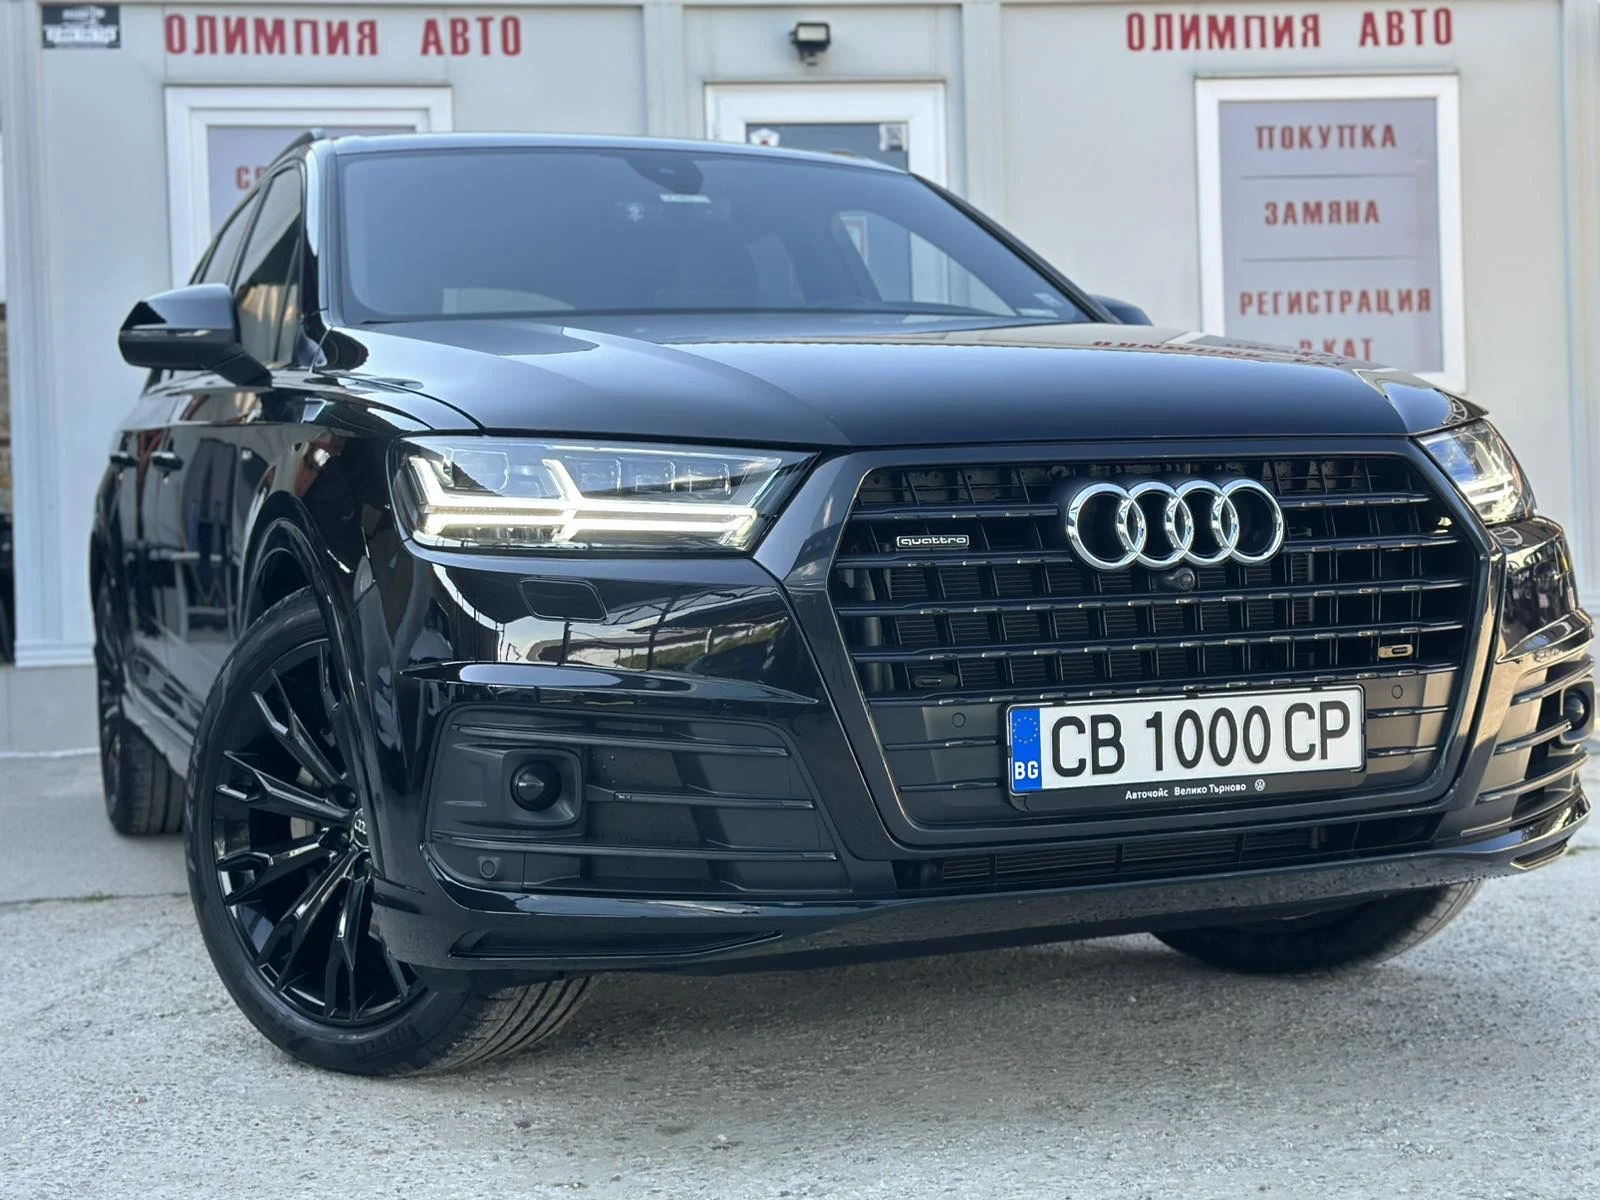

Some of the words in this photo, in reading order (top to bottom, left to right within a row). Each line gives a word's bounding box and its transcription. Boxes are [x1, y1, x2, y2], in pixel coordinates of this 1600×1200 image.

[165, 14, 379, 56] ОЛИМПИЯ
[420, 16, 523, 57] АВТО
[1126, 12, 1322, 52] ОЛИМПИЯ
[1359, 8, 1455, 48] АВТО
[1255, 124, 1398, 151] ПОКУПКА
[1264, 200, 1381, 227] ЗАМЯНА
[1239, 288, 1433, 317] РЕГИСТРАЦИЯ
[900, 536, 967, 546] quattro
[1145, 705, 1271, 772] 1000
[1014, 762, 1039, 781] BG
[1125, 788, 1169, 800] Авточойс
[1174, 785, 1208, 797] Велико
[1209, 783, 1247, 796] Търново
